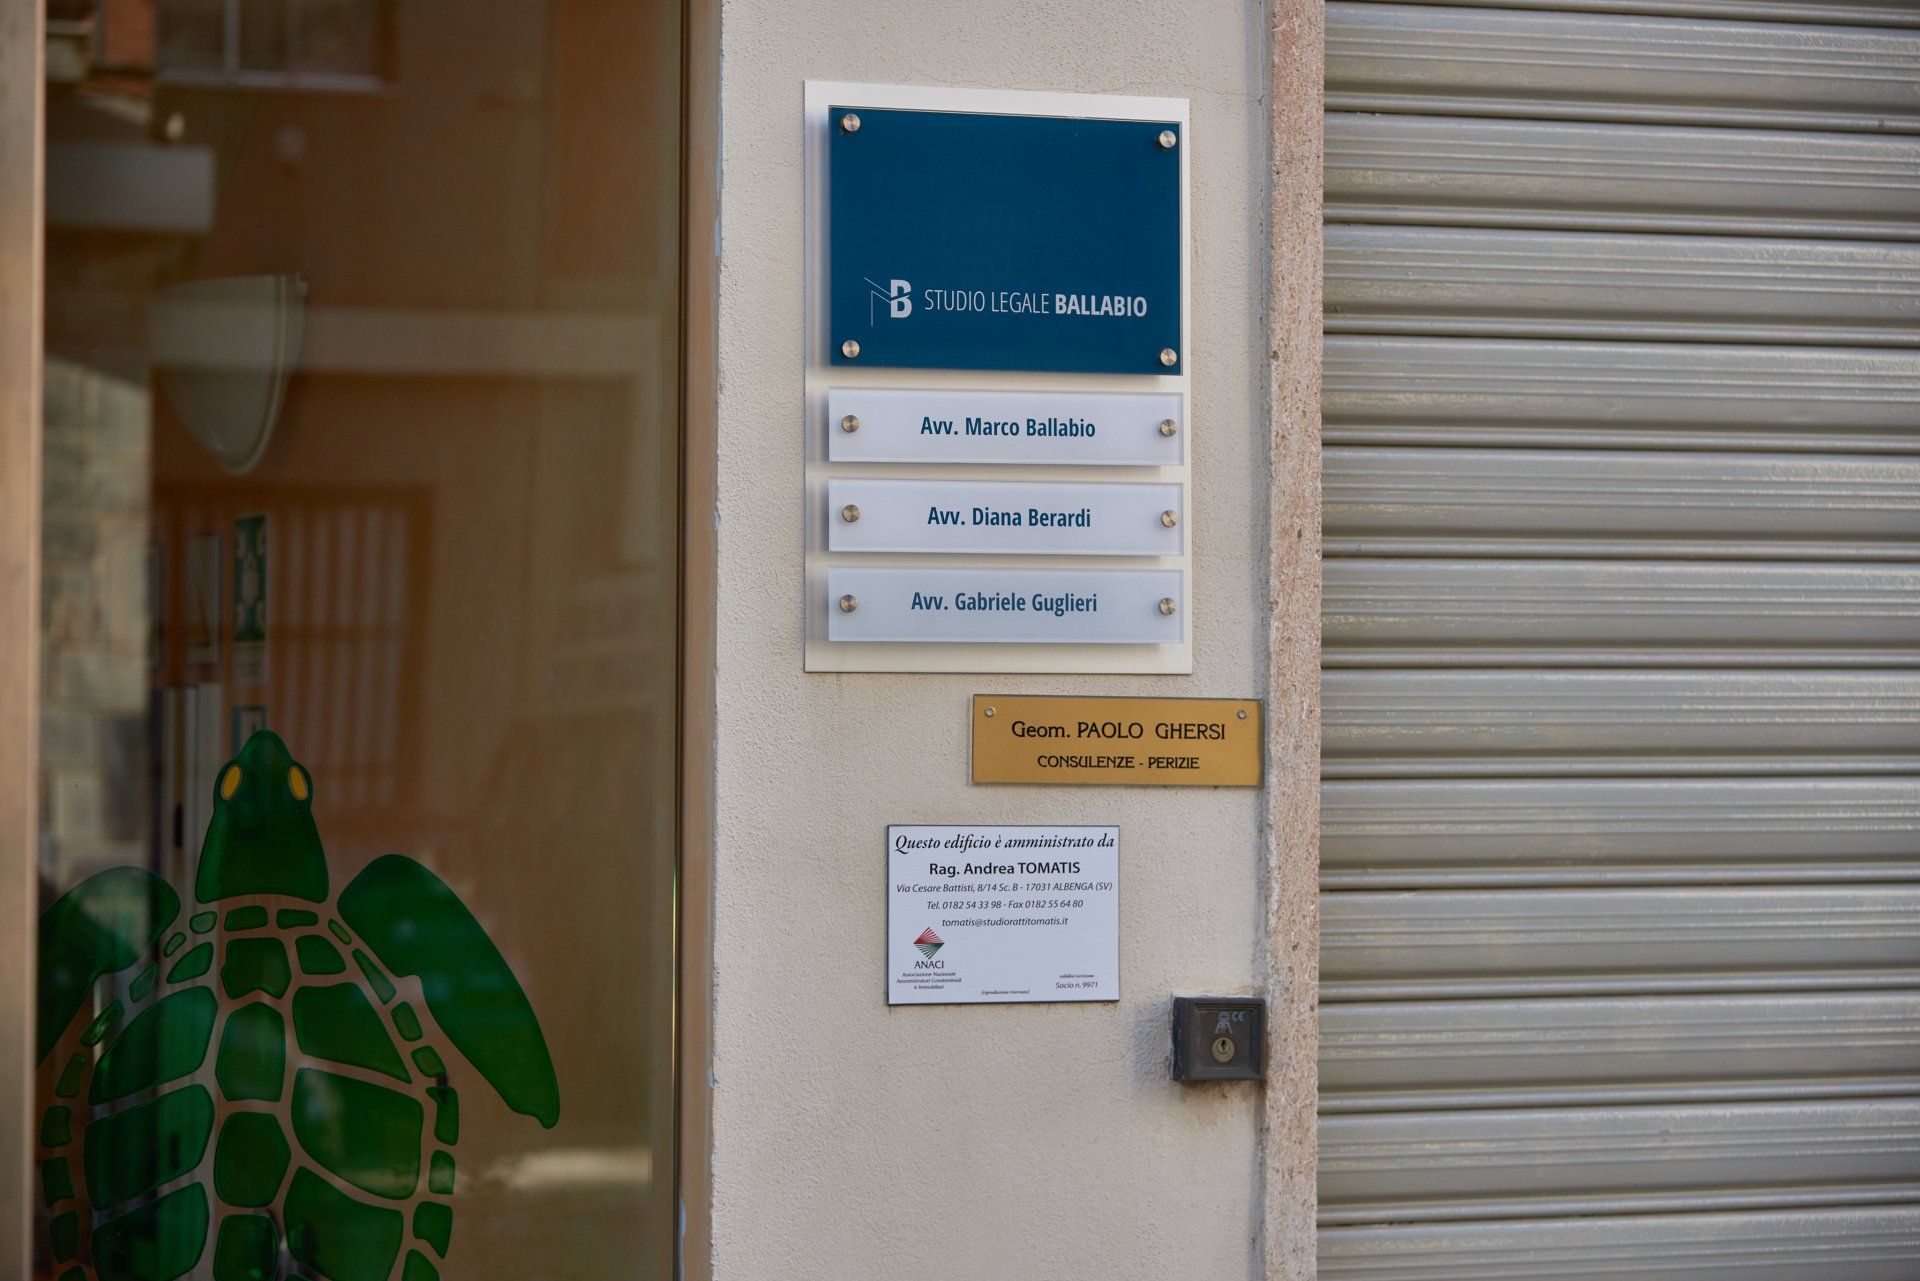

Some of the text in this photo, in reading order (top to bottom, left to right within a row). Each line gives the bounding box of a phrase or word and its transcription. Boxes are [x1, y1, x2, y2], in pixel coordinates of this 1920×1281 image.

[924, 289, 1148, 318] STUDIO LEGALE BALLABIO
[920, 416, 1096, 438] Avv. Marco Ballabio
[927, 506, 1091, 528] Avv. Diana Berardi
[910, 591, 1097, 618] Avv. Gabriele Guglieri
[1011, 720, 1226, 740] Geom. PAOLO GHERSI
[1037, 754, 1135, 769] CONSULENZE
[1147, 756, 1200, 770] PERIZIE
[895, 832, 1115, 855] Questo edificio è amministrato da
[929, 861, 1081, 878] Rag. Andrea TOMATIS
[896, 884, 911, 893] Via
[912, 883, 942, 893] Cesare
[942, 883, 976, 893] Battisti,
[977, 883, 997, 892] 8/14
[998, 883, 1011, 892] Sc.
[1012, 882, 1019, 892] B
[1026, 882, 1051, 892] 17031
[1052, 882, 1094, 891] ALBENGA
[1095, 881, 1113, 892] (SV)
[927, 900, 941, 910] Tel.
[942, 900, 965, 910] 0182
[965, 900, 977, 910] 54
[978, 900, 990, 910] 33
[990, 900, 1002, 909] 98
[1008, 900, 1024, 909] Fax
[1024, 900, 1047, 909] 0182
[1047, 899, 1059, 909] 55
[1059, 899, 1071, 908] 64
[1072, 899, 1084, 908] 80
[941, 916, 1069, 928] tomatis@studiorattitomatis.it
[914, 960, 945, 970] ANACI
[1055, 981, 1075, 989] Socio
[1082, 981, 1099, 989] 9971
